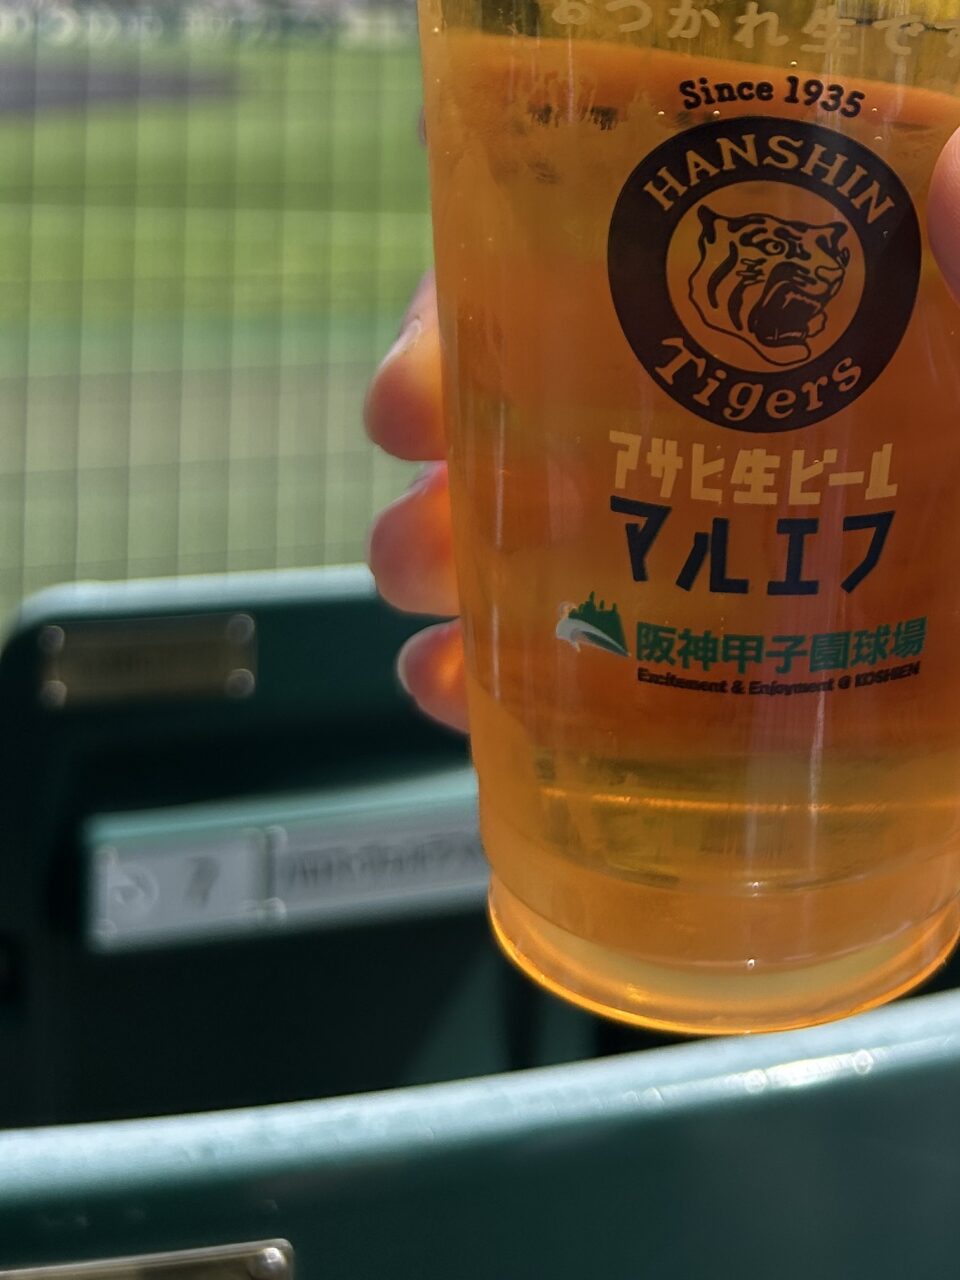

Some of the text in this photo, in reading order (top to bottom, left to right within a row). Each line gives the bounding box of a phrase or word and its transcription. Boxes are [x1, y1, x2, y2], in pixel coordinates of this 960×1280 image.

[679, 75, 866, 118] Since 1935
[643, 133, 895, 224] HANSHIN
[655, 336, 862, 421] Tigers
[609, 430, 898, 505] アサヒ生ビール
[610, 495, 896, 595] マルエフ
[636, 616, 927, 675] 阪神甲子園球場
[637, 667, 727, 694] Excitement
[731, 679, 746, 695] &
[749, 678, 835, 696] Enjoyment
